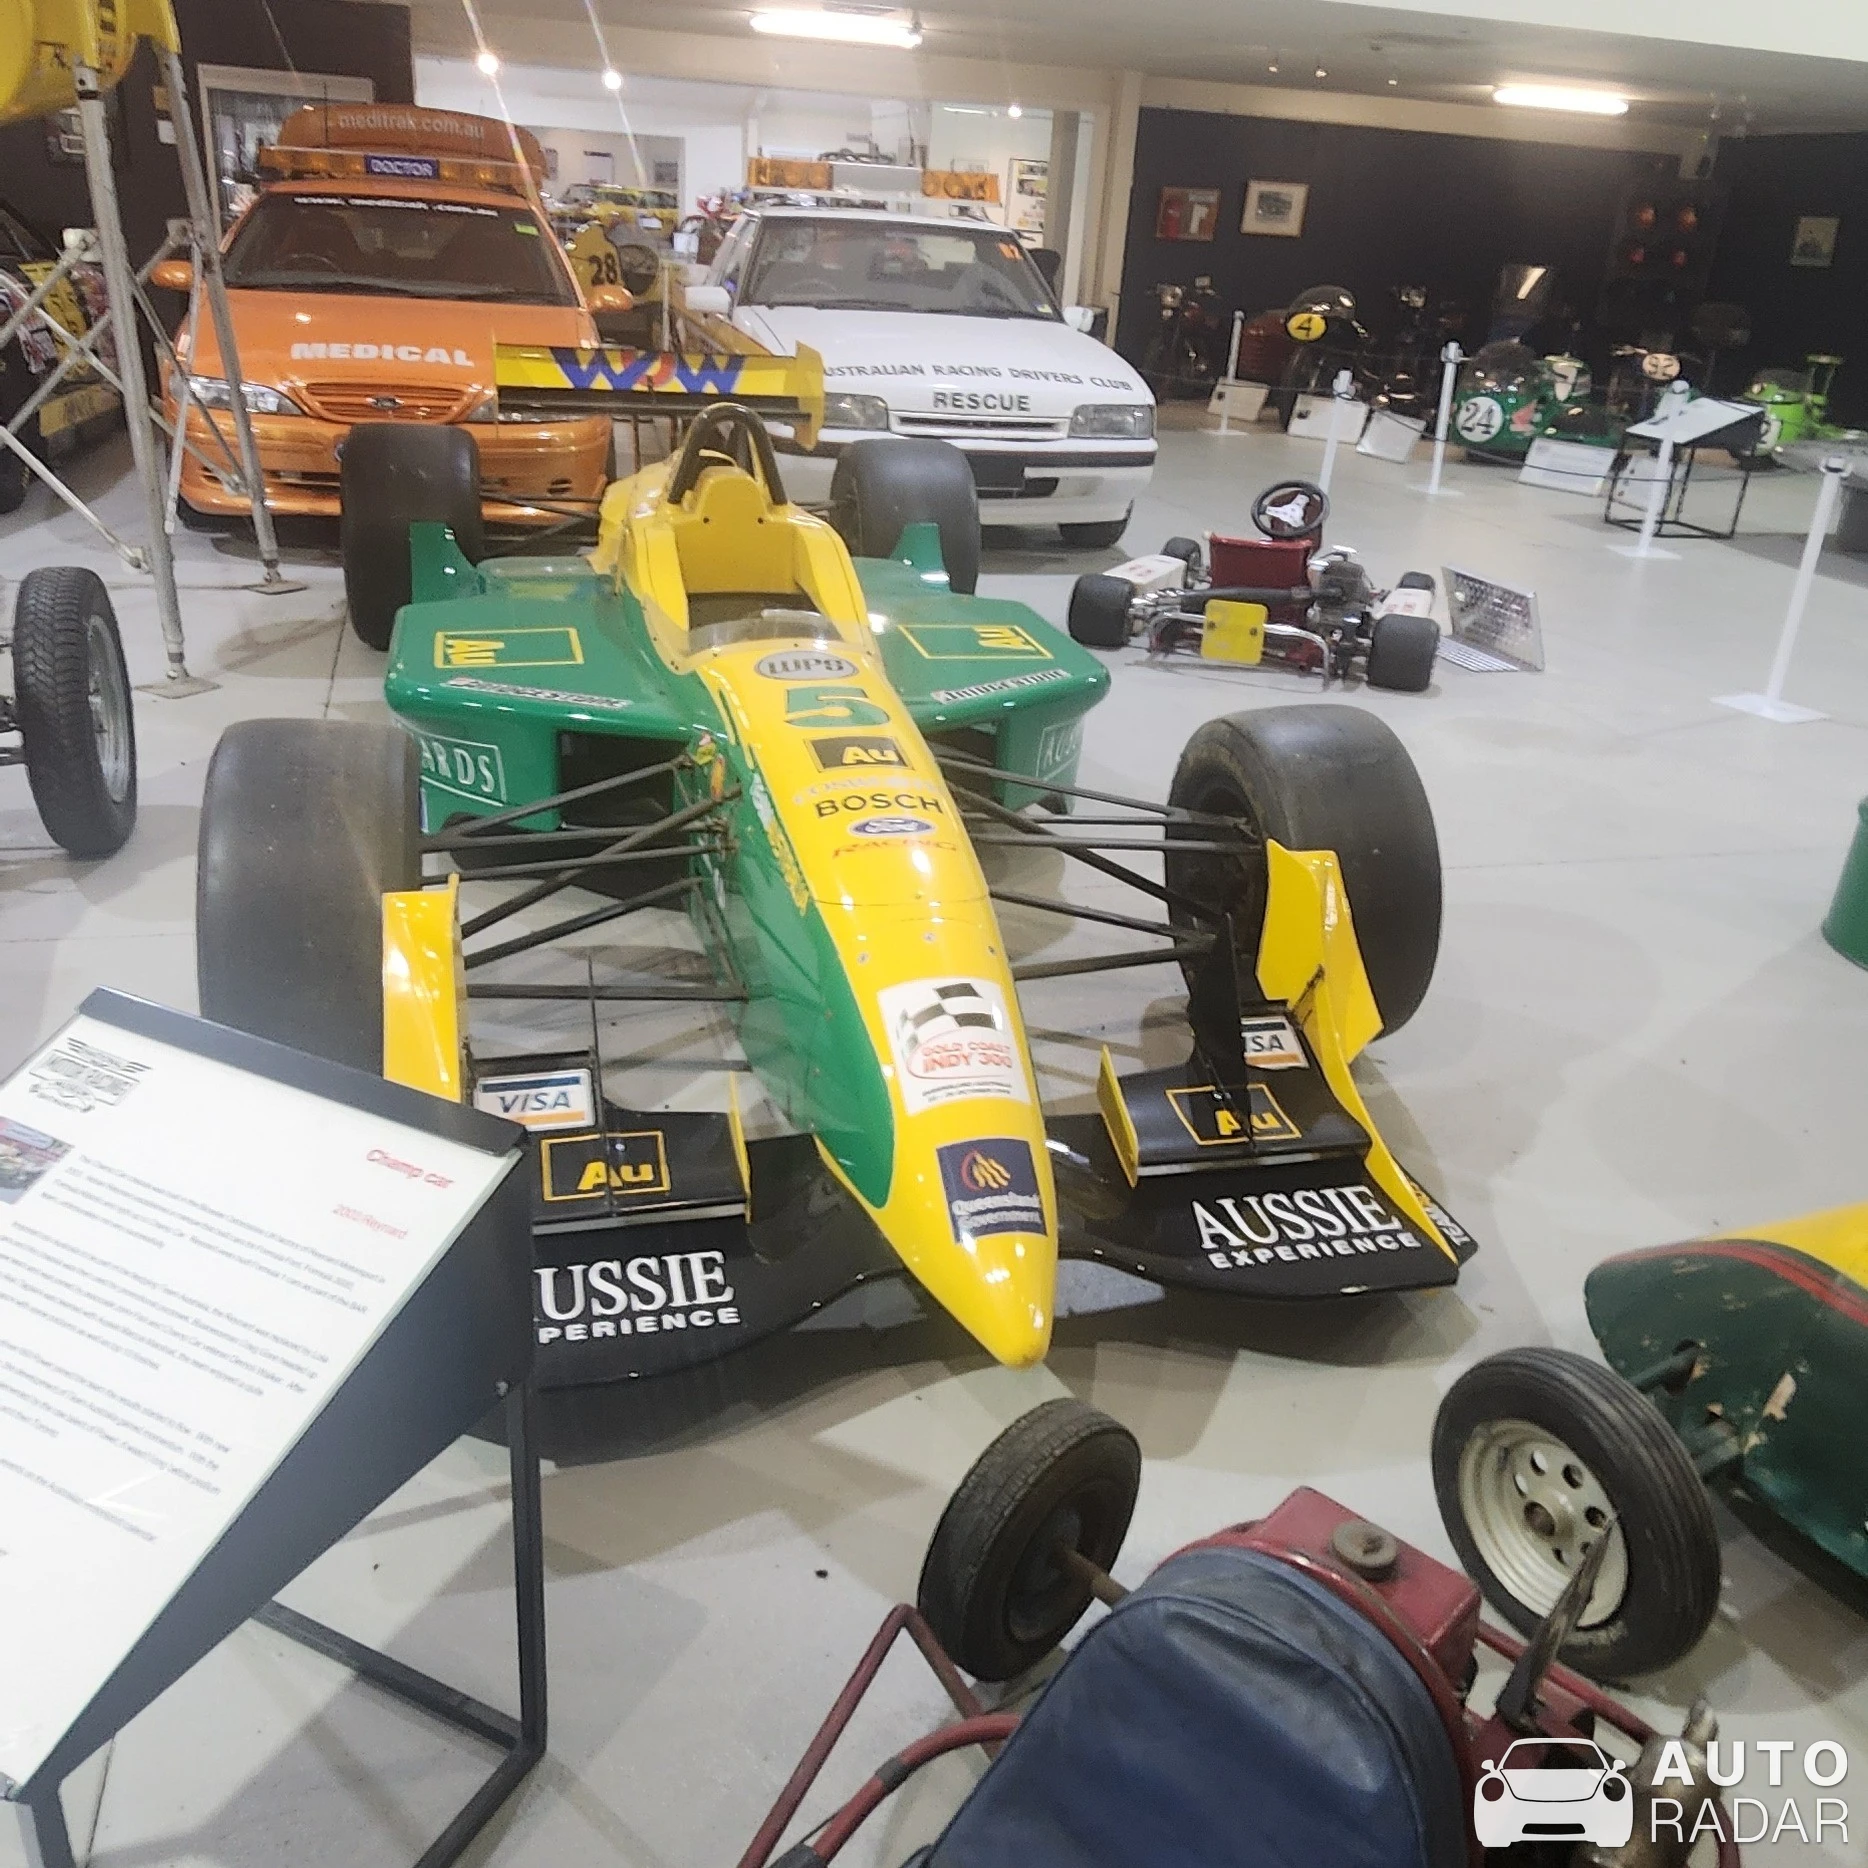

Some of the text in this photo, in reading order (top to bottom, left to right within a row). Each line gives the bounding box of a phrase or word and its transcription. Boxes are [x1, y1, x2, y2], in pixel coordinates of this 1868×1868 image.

[370, 158, 434, 177] DOCTOR
[589, 252, 618, 286] 28
[1296, 316, 1313, 338] 4
[290, 342, 475, 368] MEDICAL
[931, 364, 1002, 379] RACING
[1007, 367, 1084, 386] DRIVERS
[1089, 375, 1134, 392] CLUB
[932, 391, 1032, 413] RESCUE
[1461, 401, 1496, 436] 24
[784, 685, 891, 728] 5
[815, 793, 944, 819] BOSCH
[922, 1051, 973, 1074] INDY
[498, 1091, 571, 1114] VISA
[366, 1149, 455, 1189] Champ car
[576, 1160, 655, 1192] Au
[1191, 1185, 1403, 1251] AUSSIE
[1207, 1231, 1422, 1271] EXPERIENCE
